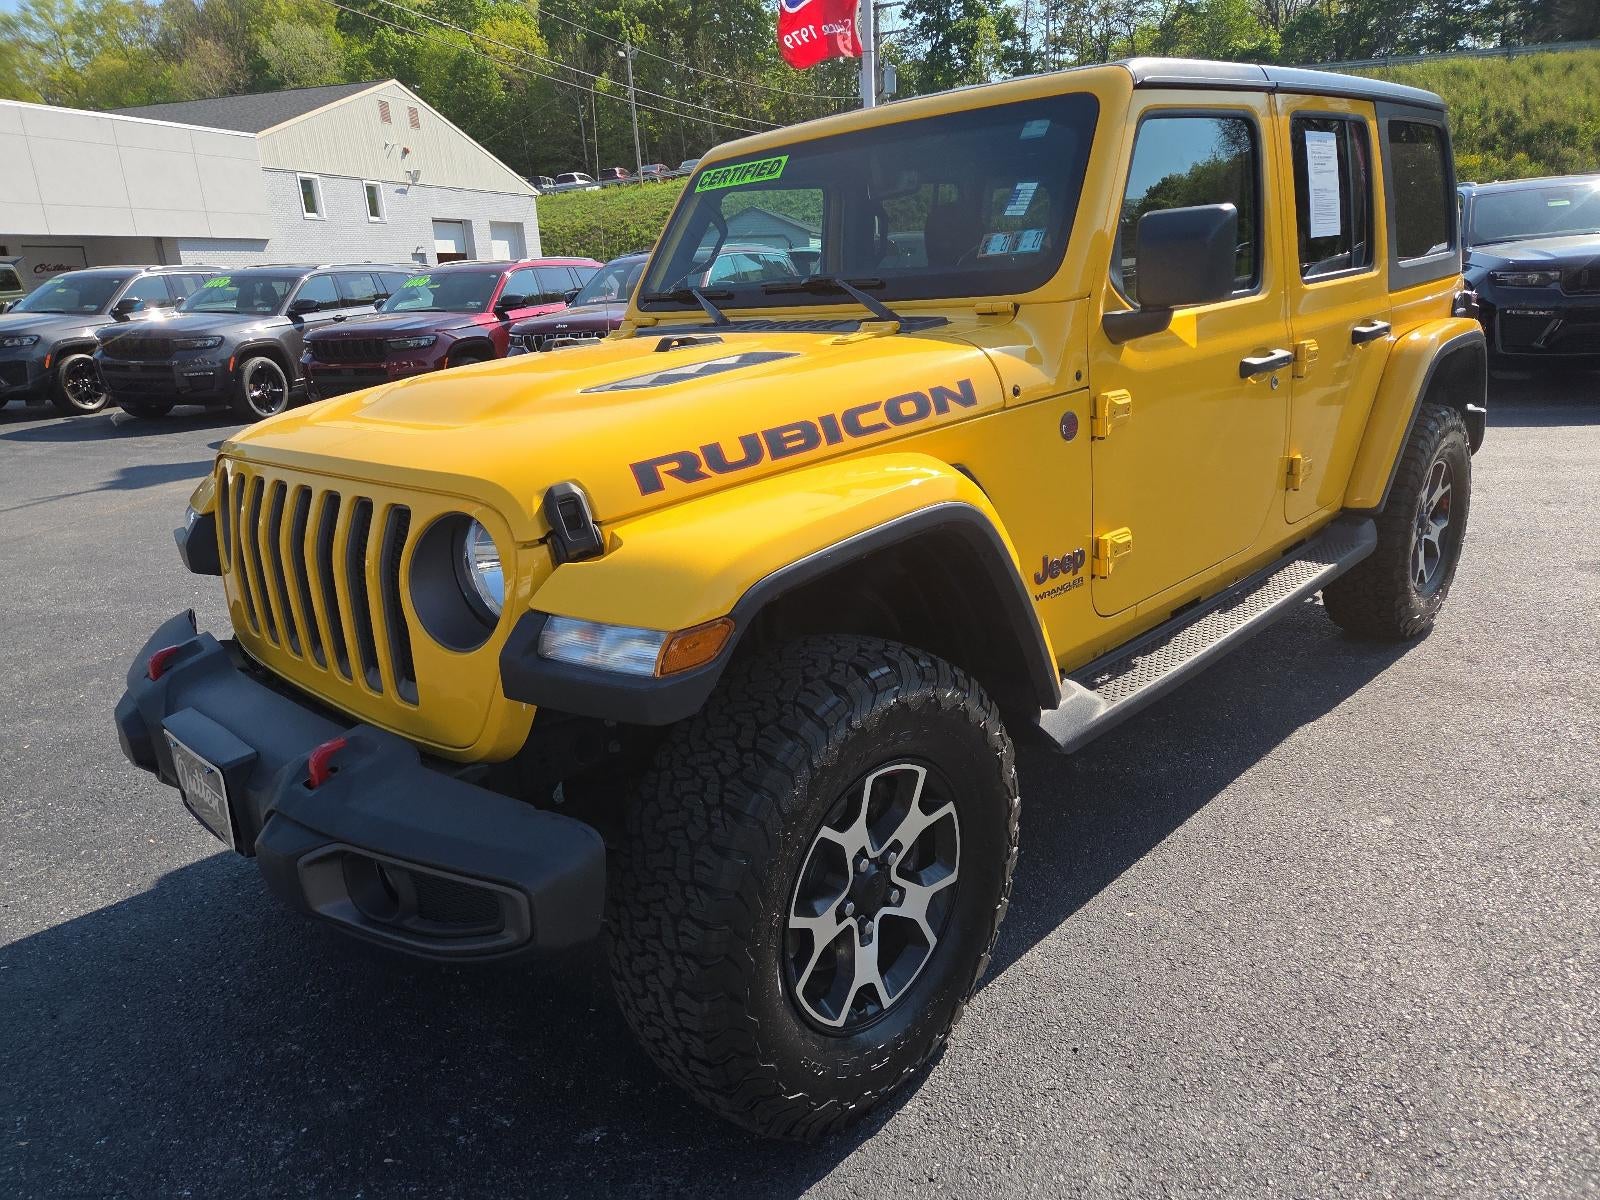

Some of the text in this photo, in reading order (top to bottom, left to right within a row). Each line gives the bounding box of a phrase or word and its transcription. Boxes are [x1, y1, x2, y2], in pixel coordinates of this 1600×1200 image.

[699, 159, 783, 187] CERTIFIED
[629, 378, 978, 496] RUBICON
[1033, 548, 1086, 586] Jeep
[1034, 577, 1083, 601] WRANGLER
